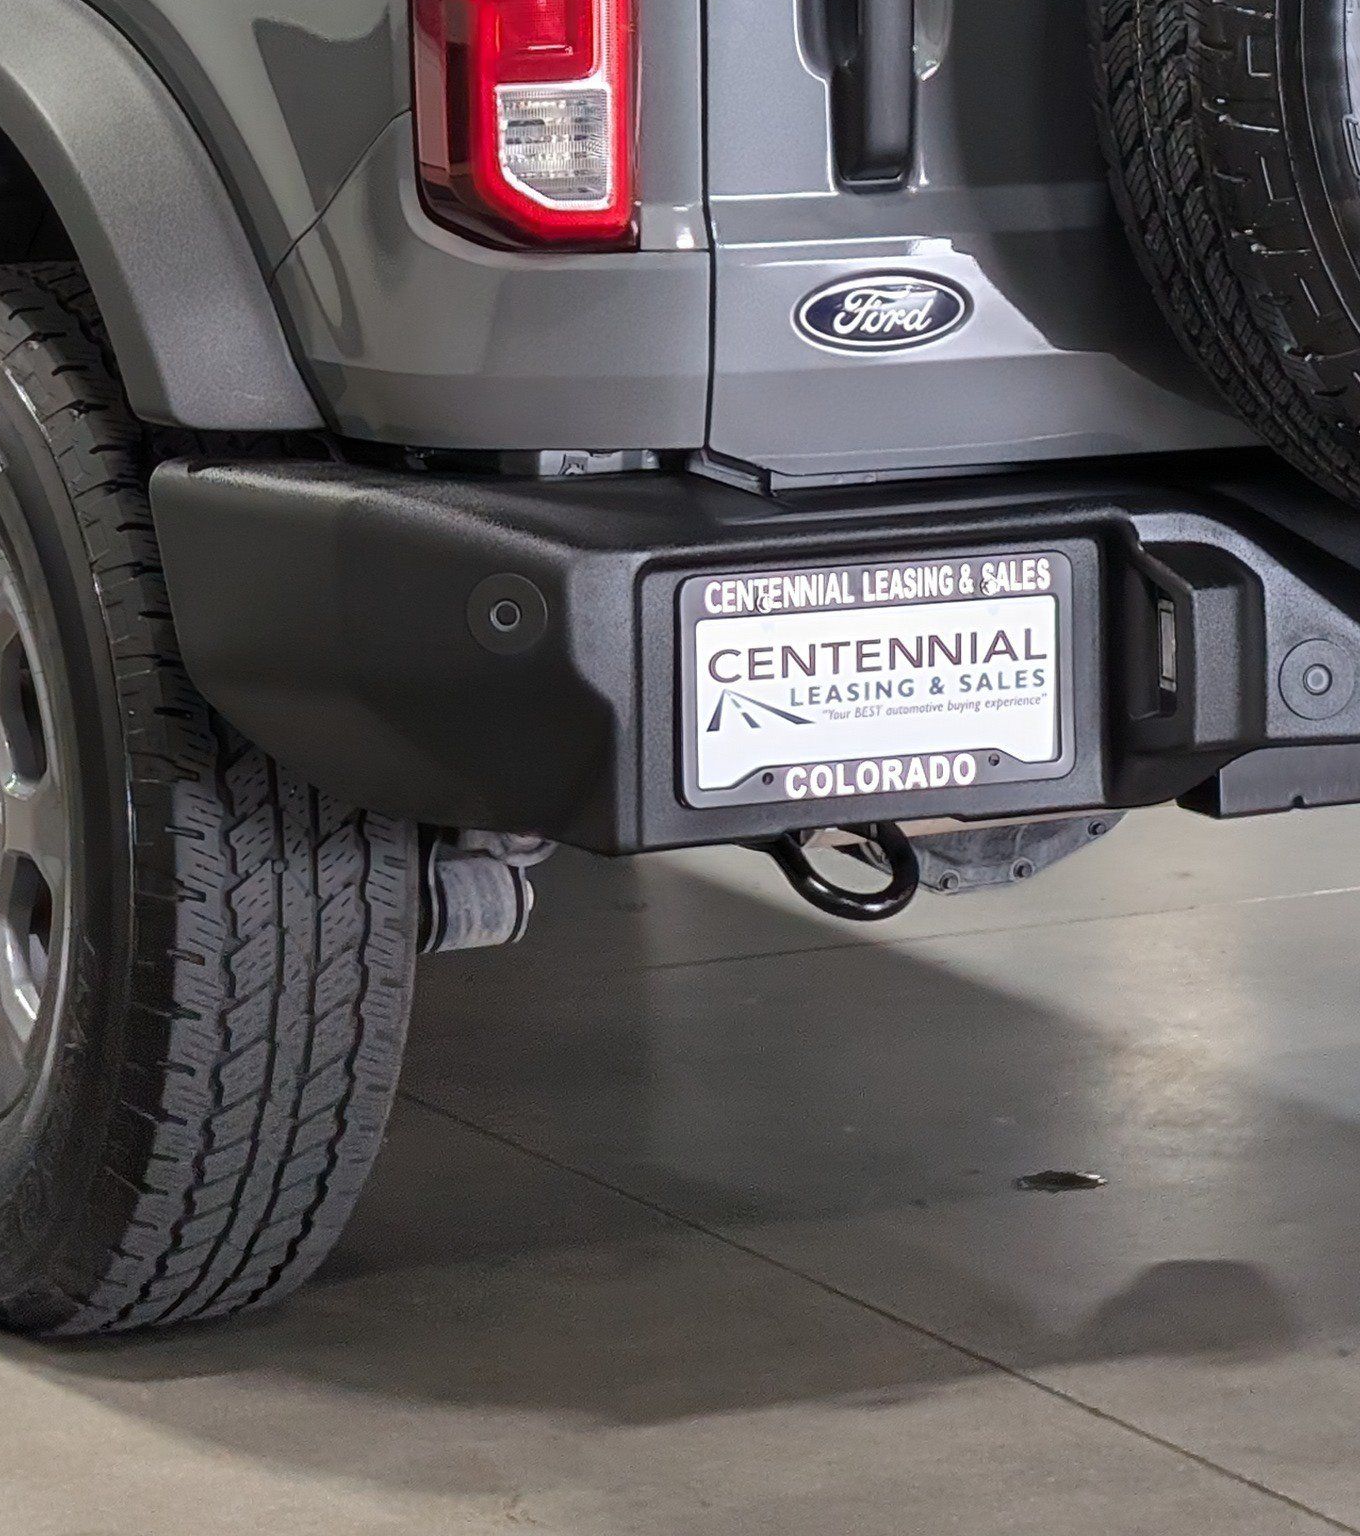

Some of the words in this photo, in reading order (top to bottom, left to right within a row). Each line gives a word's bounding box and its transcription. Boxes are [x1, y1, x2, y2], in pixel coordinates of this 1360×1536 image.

[832, 283, 939, 335] Ford
[704, 571, 855, 615] CENTENNIAL
[862, 565, 954, 603] LEASING
[958, 563, 974, 594] &
[981, 557, 1051, 597] SALES
[708, 628, 1048, 683] CENTENNIAL
[790, 678, 915, 707] LEASING
[928, 676, 945, 696] &
[959, 668, 1046, 693] SALES
[854, 704, 883, 719] BEST
[886, 701, 944, 716] automotive
[947, 695, 981, 713] buying
[784, 752, 976, 800] COLORADO
